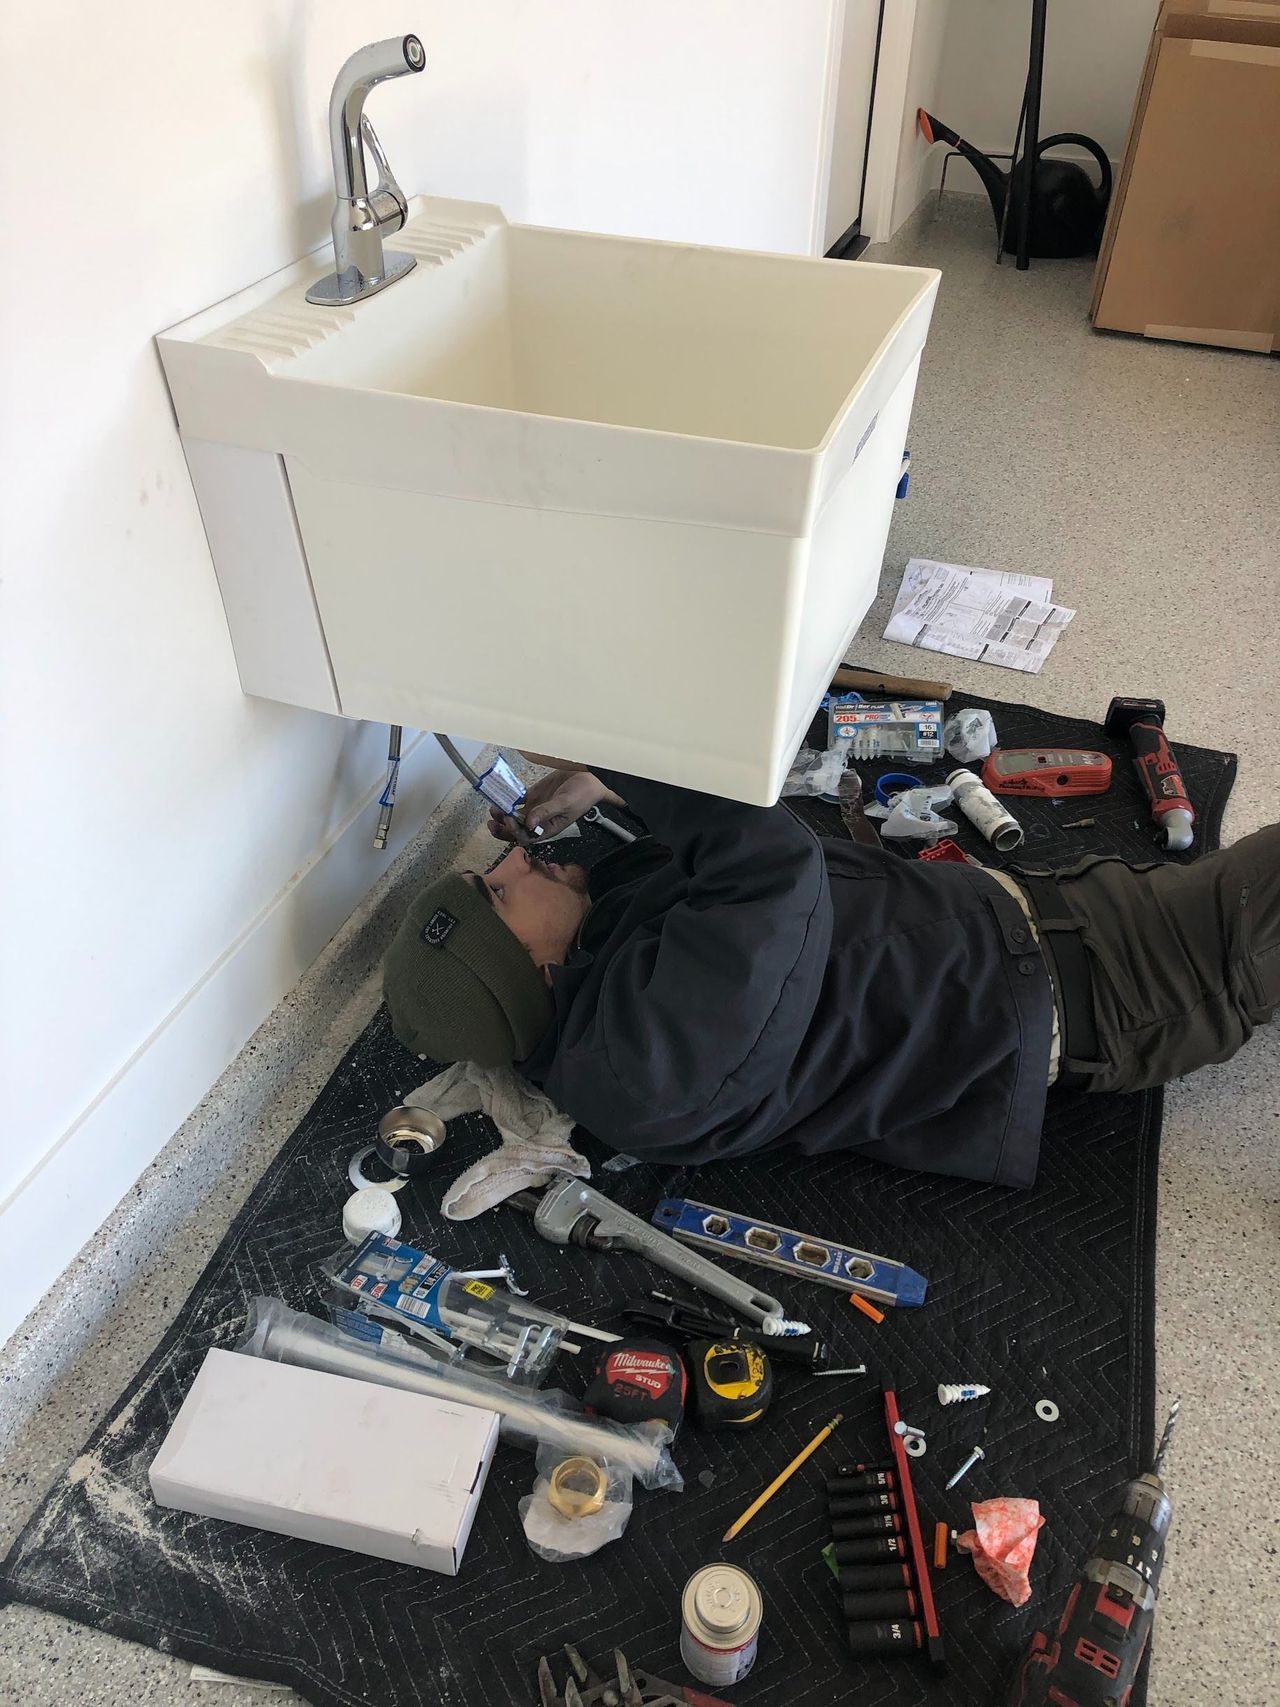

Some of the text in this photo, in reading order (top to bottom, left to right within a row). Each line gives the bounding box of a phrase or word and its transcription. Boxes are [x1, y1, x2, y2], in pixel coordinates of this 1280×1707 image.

[836, 715, 857, 723] 205
[613, 1352, 671, 1369] Milwaukee
[635, 1374, 661, 1389] STUD
[614, 1383, 648, 1401] 25FT
[888, 1538, 896, 1551] 1/2
[892, 1624, 901, 1639] 3/4
